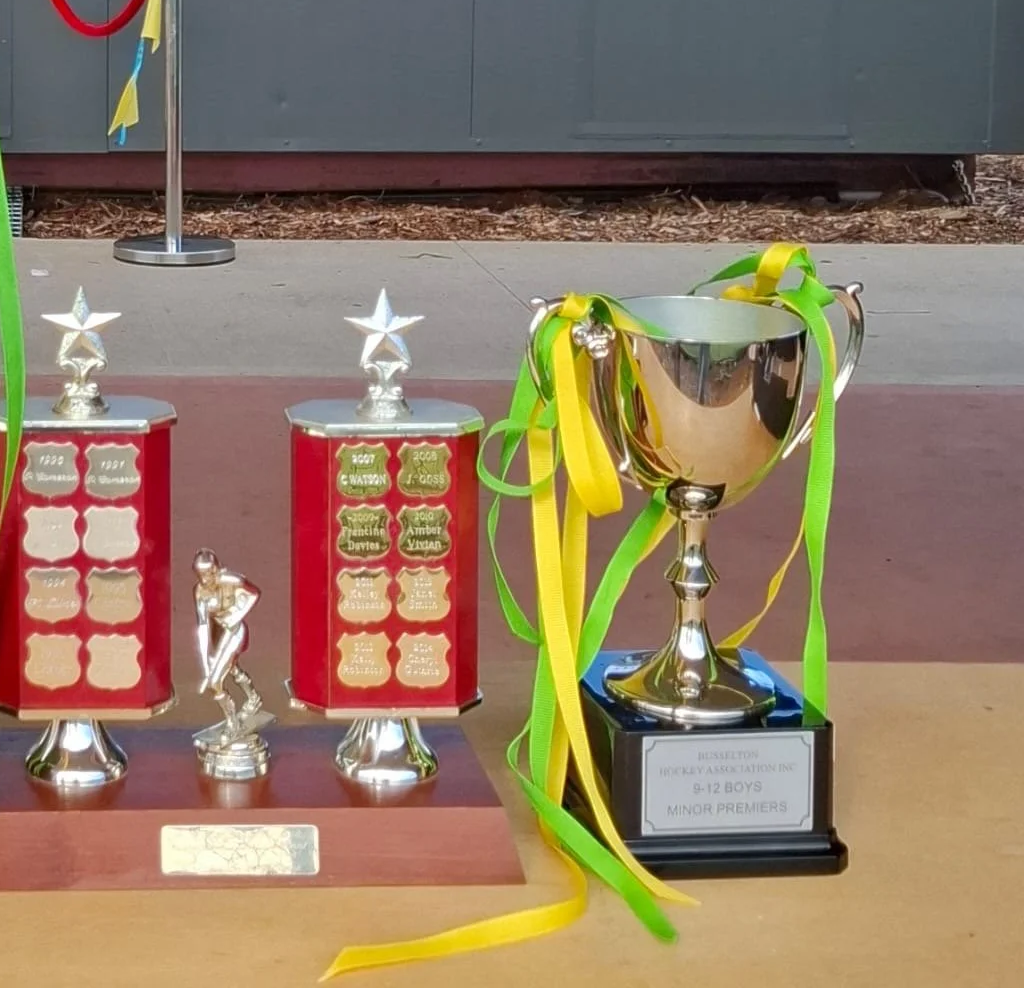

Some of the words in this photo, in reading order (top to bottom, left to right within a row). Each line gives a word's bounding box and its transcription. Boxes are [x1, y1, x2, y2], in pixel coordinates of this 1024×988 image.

[693, 782, 720, 794] 9-12
[725, 781, 762, 793] BOYS
[667, 805, 712, 816] MINOR
[717, 801, 787, 814] PREMIERS
